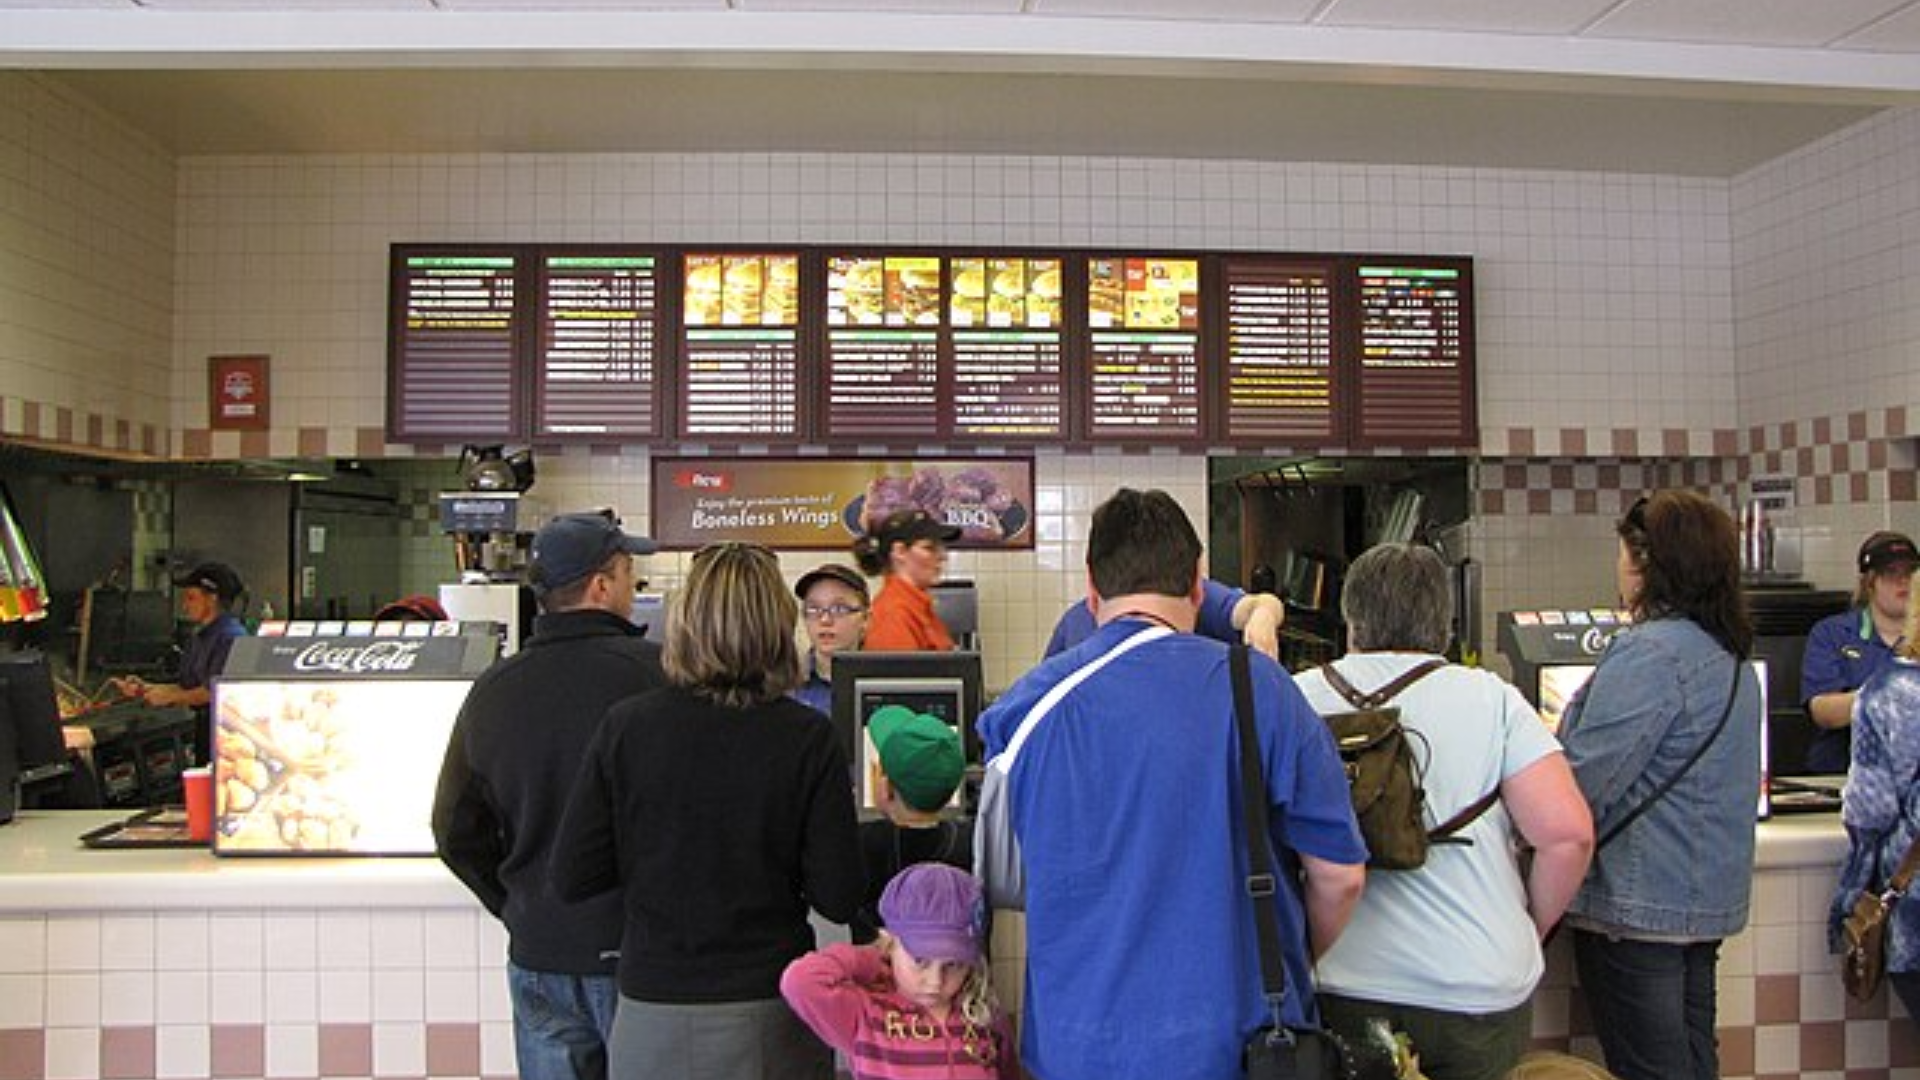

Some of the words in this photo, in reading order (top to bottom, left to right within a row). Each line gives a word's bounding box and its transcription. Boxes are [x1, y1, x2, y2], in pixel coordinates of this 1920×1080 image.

[698, 497, 724, 511] Enjoy
[728, 497, 744, 507] the
[747, 496, 791, 508] premium
[794, 494, 820, 505] taste
[822, 492, 835, 504] of
[691, 507, 776, 530] Boneless
[782, 506, 838, 528] Wings
[943, 509, 991, 529] BBQ
